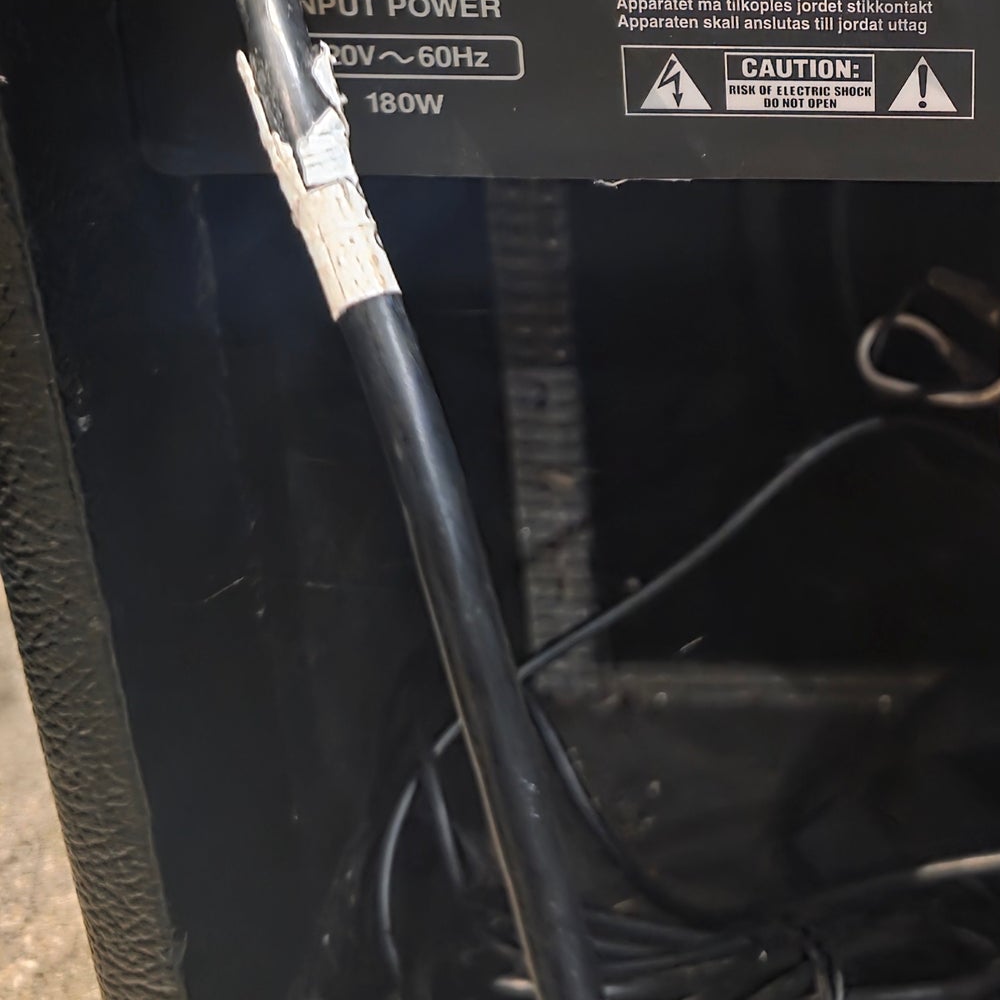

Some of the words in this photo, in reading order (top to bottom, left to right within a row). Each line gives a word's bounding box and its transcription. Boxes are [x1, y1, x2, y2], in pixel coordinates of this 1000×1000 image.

[847, 0, 933, 14] stikkontakt
[617, 14, 699, 32] Apparaten
[703, 15, 740, 30] skall
[744, 16, 810, 30] anslutas
[814, 16, 834, 31] till
[837, 16, 884, 35] jordat
[888, 18, 927, 35] uttag
[741, 56, 860, 80] CAUTION:
[728, 84, 756, 97] RISK
[759, 84, 773, 97] OF
[776, 85, 832, 97] ELECTRIC
[834, 85, 872, 98] SHOCK
[365, 91, 444, 115] 180W
[763, 98, 780, 109] DO
[782, 98, 806, 109] NOT
[807, 98, 837, 110] OPEN
